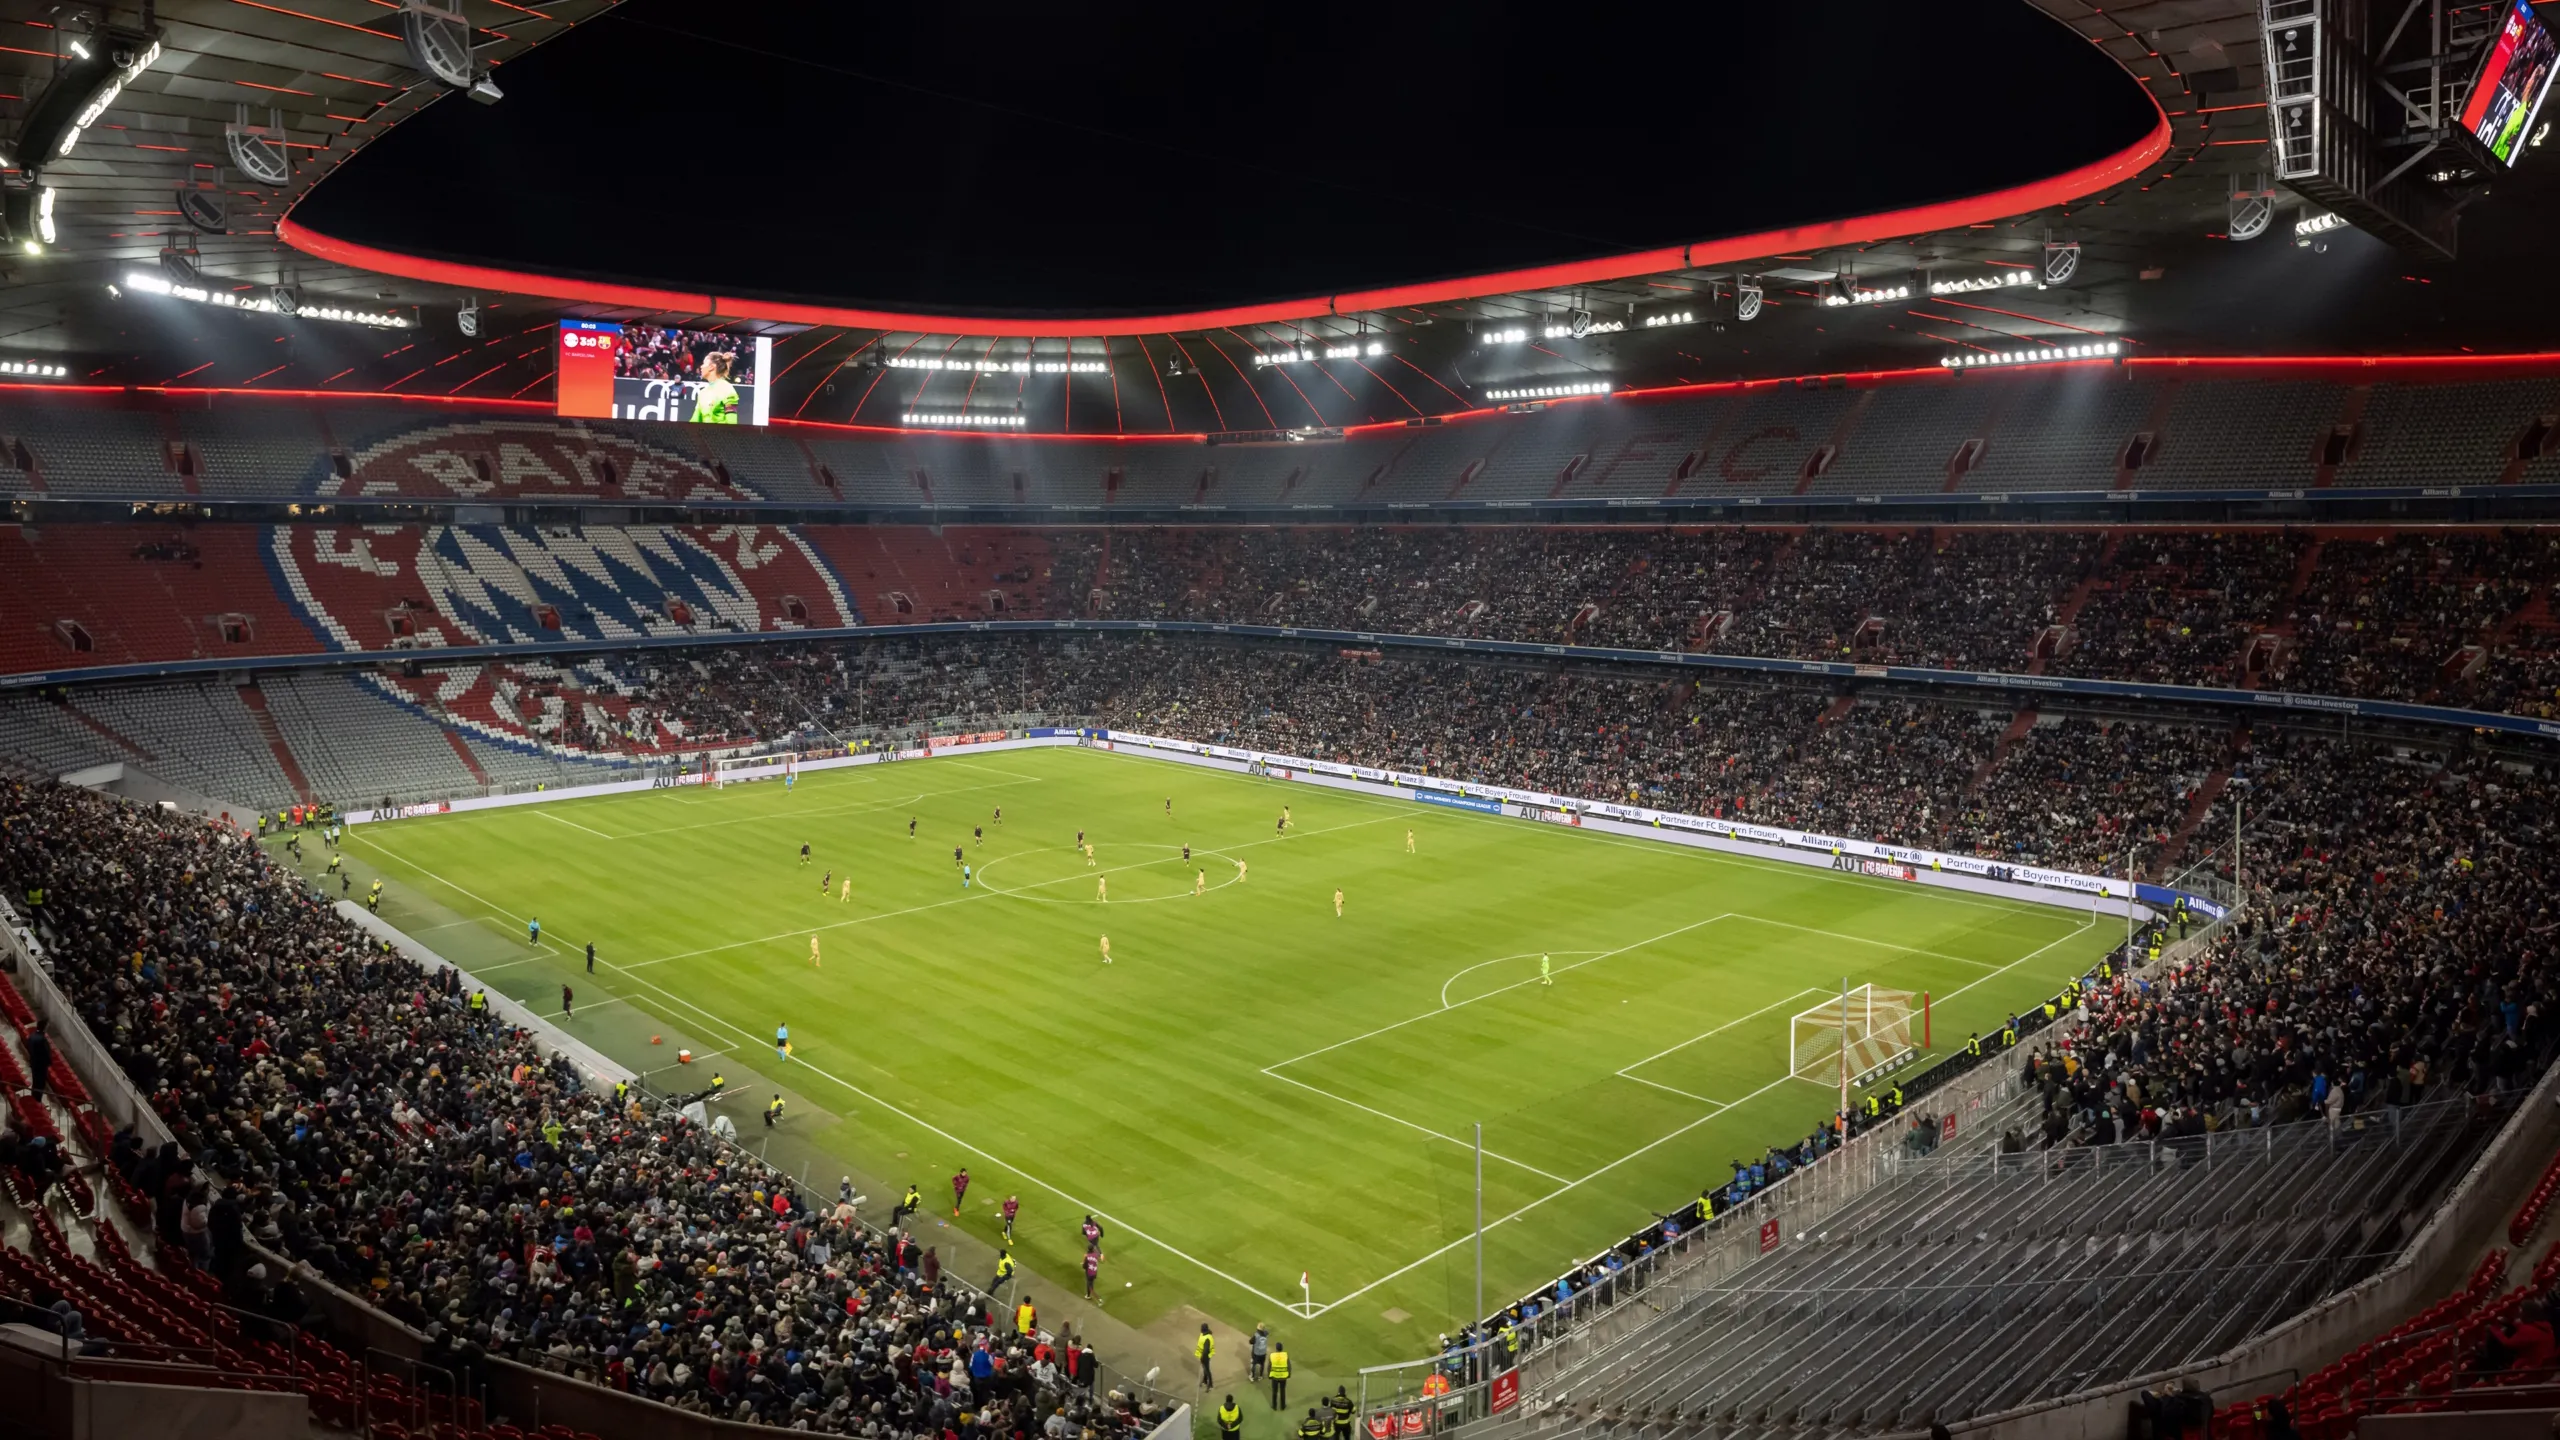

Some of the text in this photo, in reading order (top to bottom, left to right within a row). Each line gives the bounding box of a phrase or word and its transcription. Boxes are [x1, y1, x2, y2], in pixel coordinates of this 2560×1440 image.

[580, 336, 597, 347] 3:0
[2031, 680, 2063, 688] Investors
[2254, 694, 2359, 709] Allianz Global Investors
[413, 803, 440, 816] BAYERN
[1605, 805, 1631, 816] Allianz
[1661, 814, 1689, 825] Partner
[1691, 818, 1704, 827] der
[1706, 821, 1716, 830] FC
[1801, 835, 1833, 848] Allianz
[1874, 846, 1908, 858] Allianz
[1875, 862, 1903, 878] BAYERN
[1946, 857, 1984, 872] Partner
[2023, 868, 2060, 884] Bayern
[2188, 896, 2216, 916] Allianz
